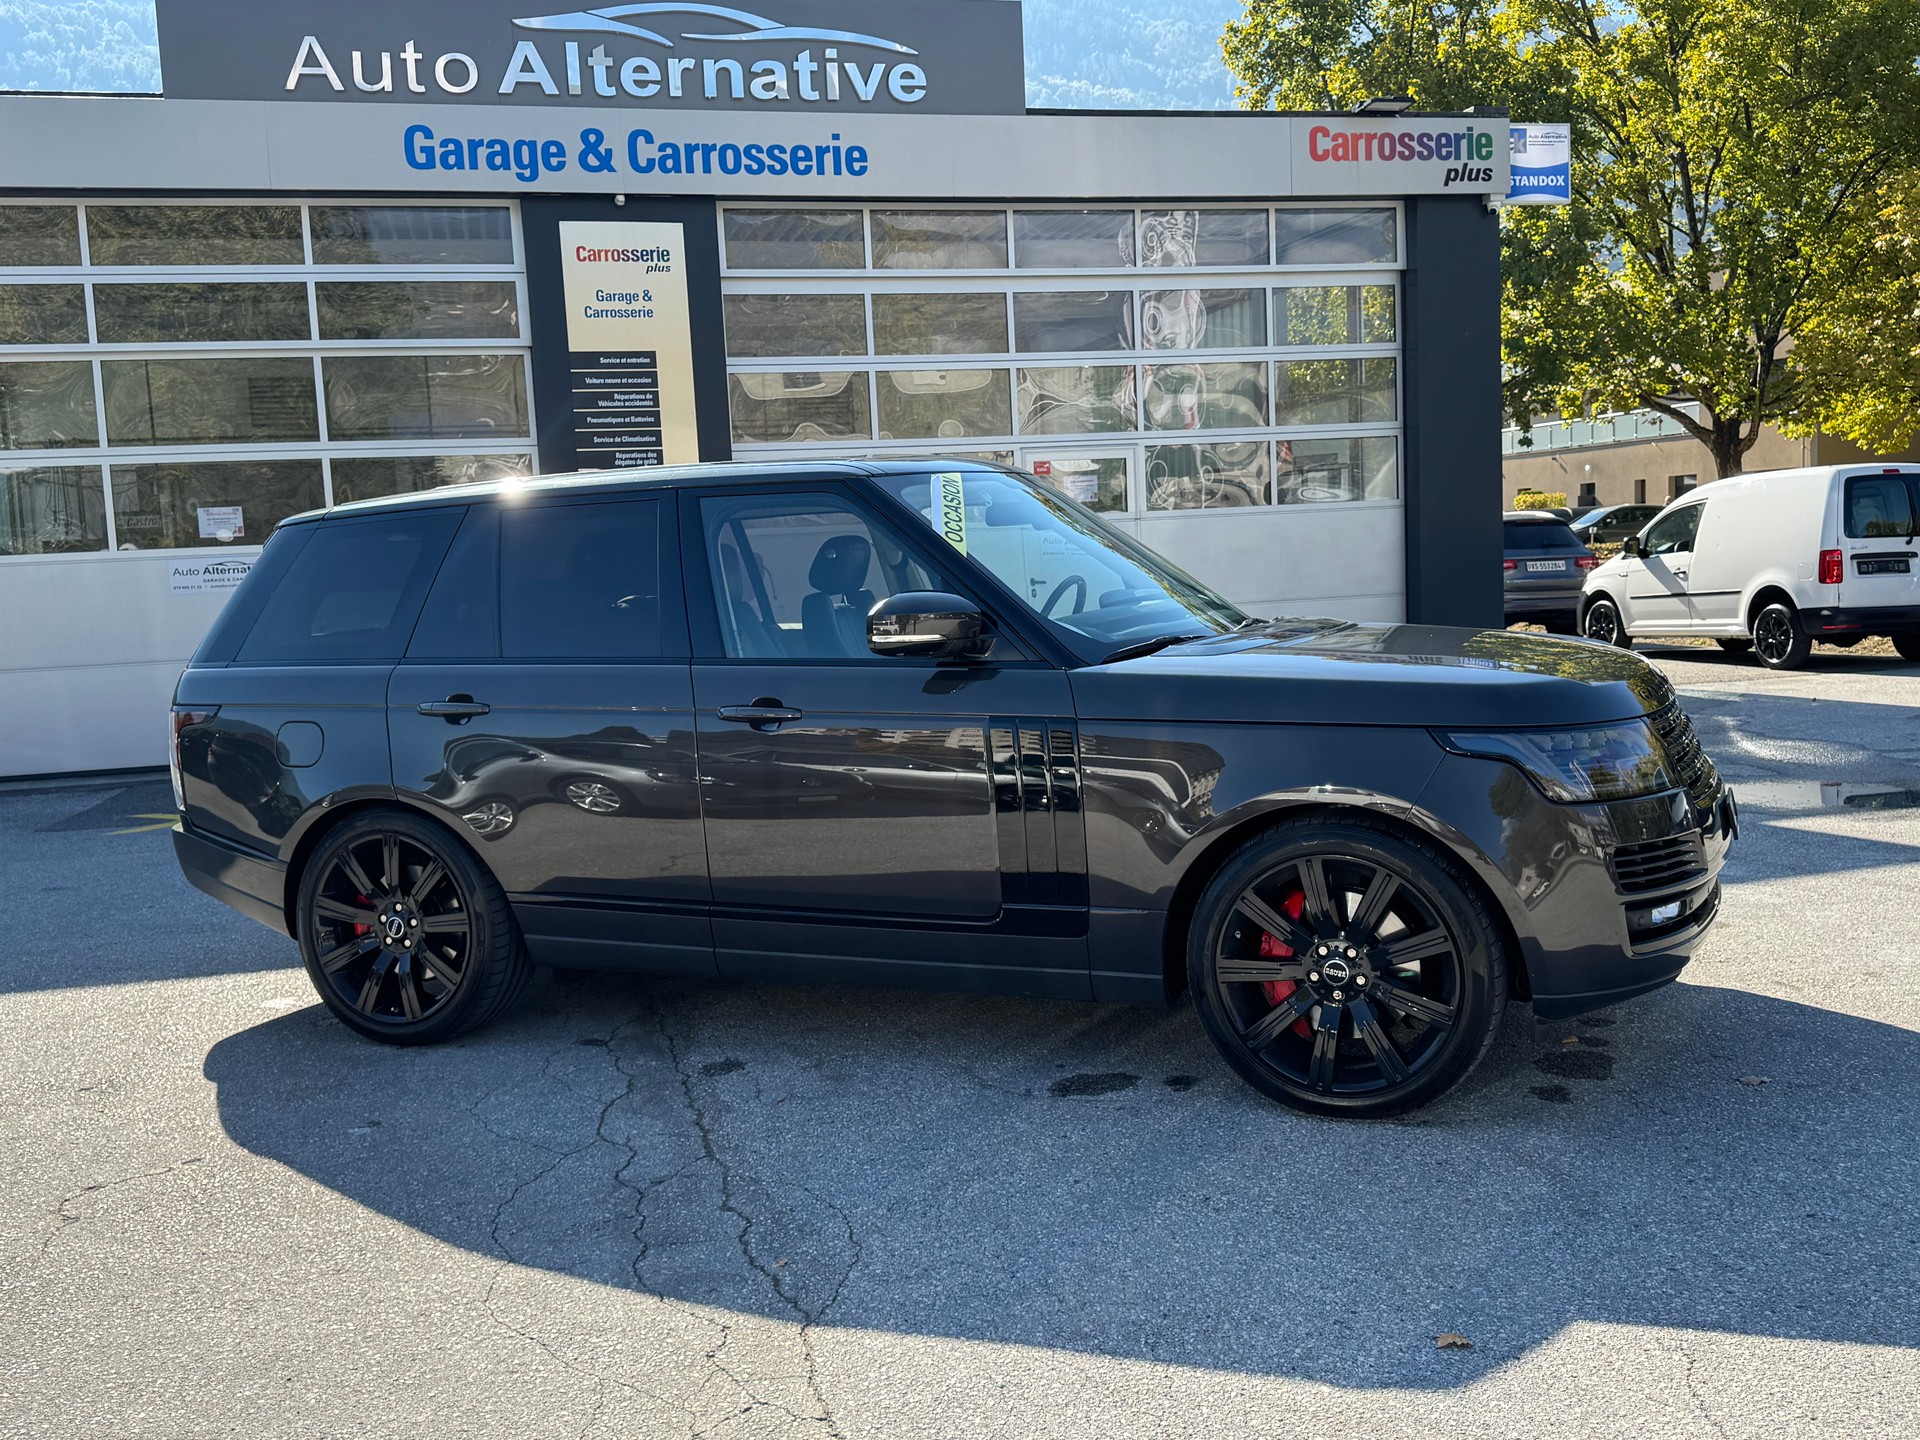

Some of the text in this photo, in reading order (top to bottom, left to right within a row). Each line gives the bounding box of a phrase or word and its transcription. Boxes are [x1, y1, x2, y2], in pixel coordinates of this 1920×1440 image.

[285, 35, 928, 103] Auto Alternative
[1309, 125, 1493, 162] Carrosserie
[403, 124, 868, 182] Garage & Carrosserie
[1443, 163, 1493, 187] plus
[576, 246, 670, 262] Carrosserie
[646, 263, 671, 274] plus
[596, 289, 653, 305] Garage &
[584, 305, 654, 318] Carrosserie
[587, 416, 624, 424] Pneumatiques
[942, 475, 964, 543] OCCASION
[173, 568, 200, 576] Auto
